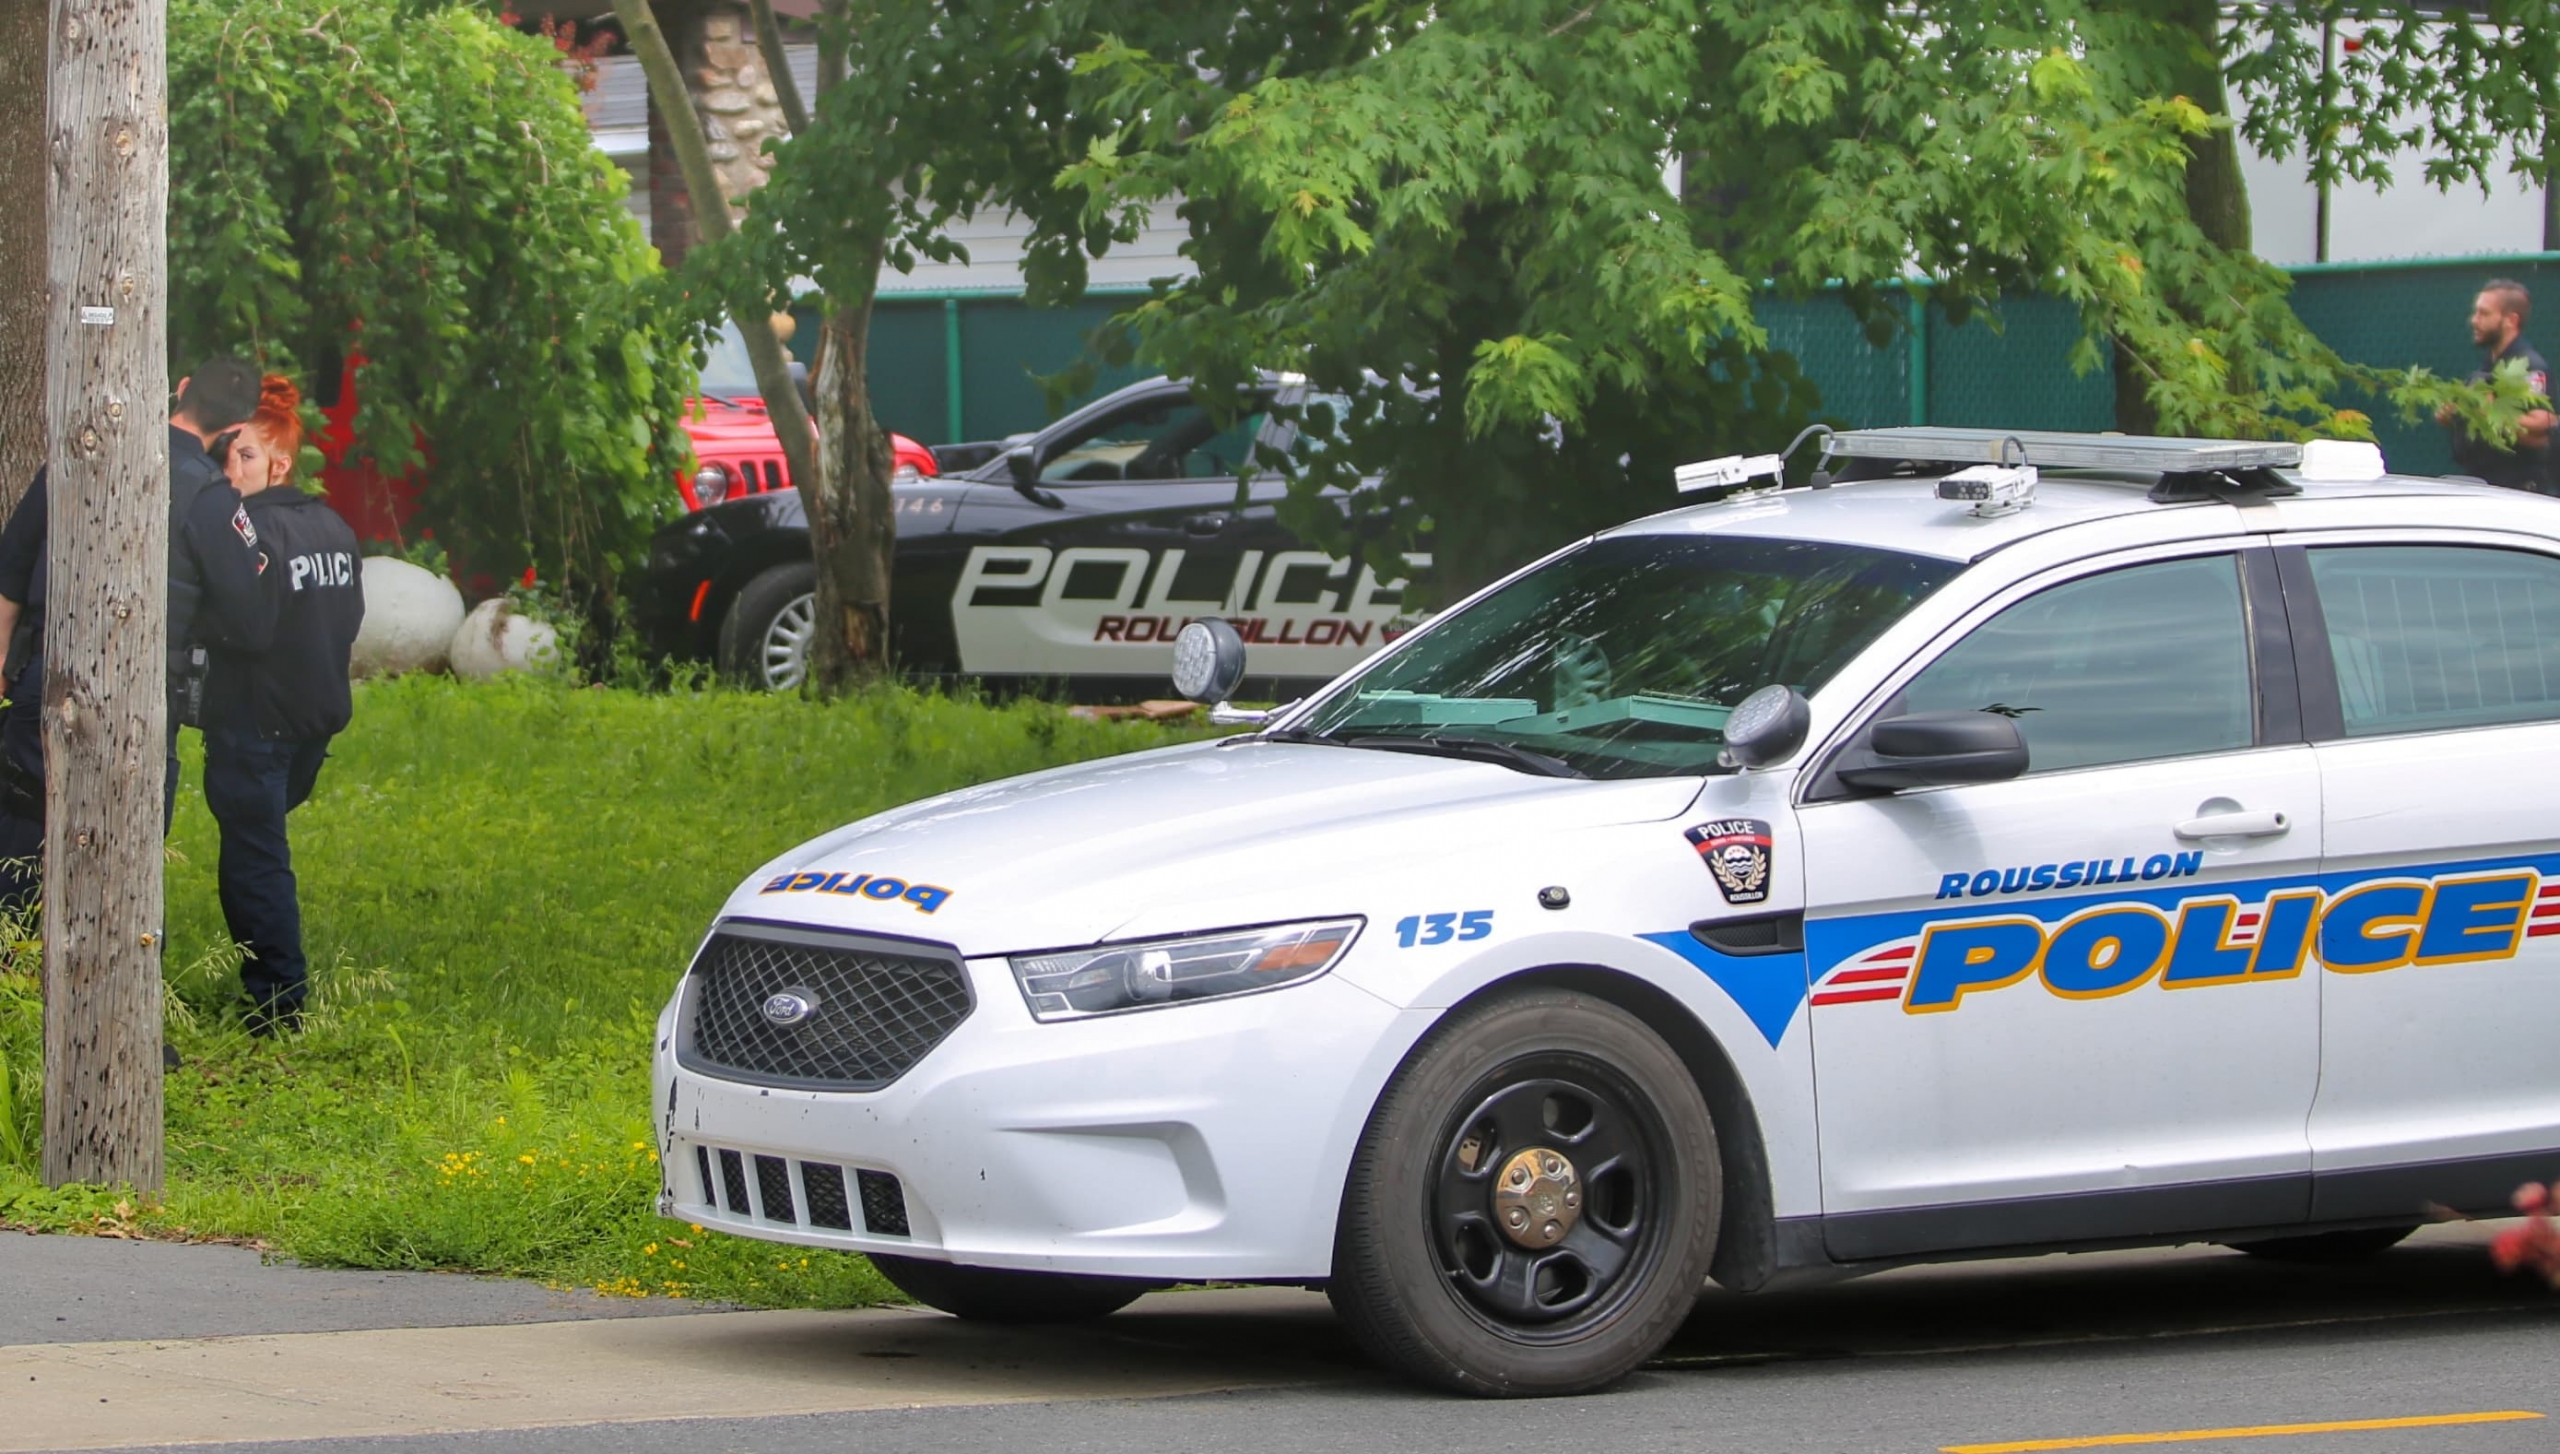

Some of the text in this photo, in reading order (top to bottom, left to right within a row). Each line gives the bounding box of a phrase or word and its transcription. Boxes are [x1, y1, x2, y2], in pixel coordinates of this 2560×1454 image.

[952, 546, 1432, 615] POLICE
[1698, 821, 1755, 840] POLICE
[1936, 850, 2203, 899] ROUSSILLON
[1395, 910, 1494, 948] 135
[1901, 872, 2536, 1015] POLICE
[769, 999, 794, 1017] Ford
